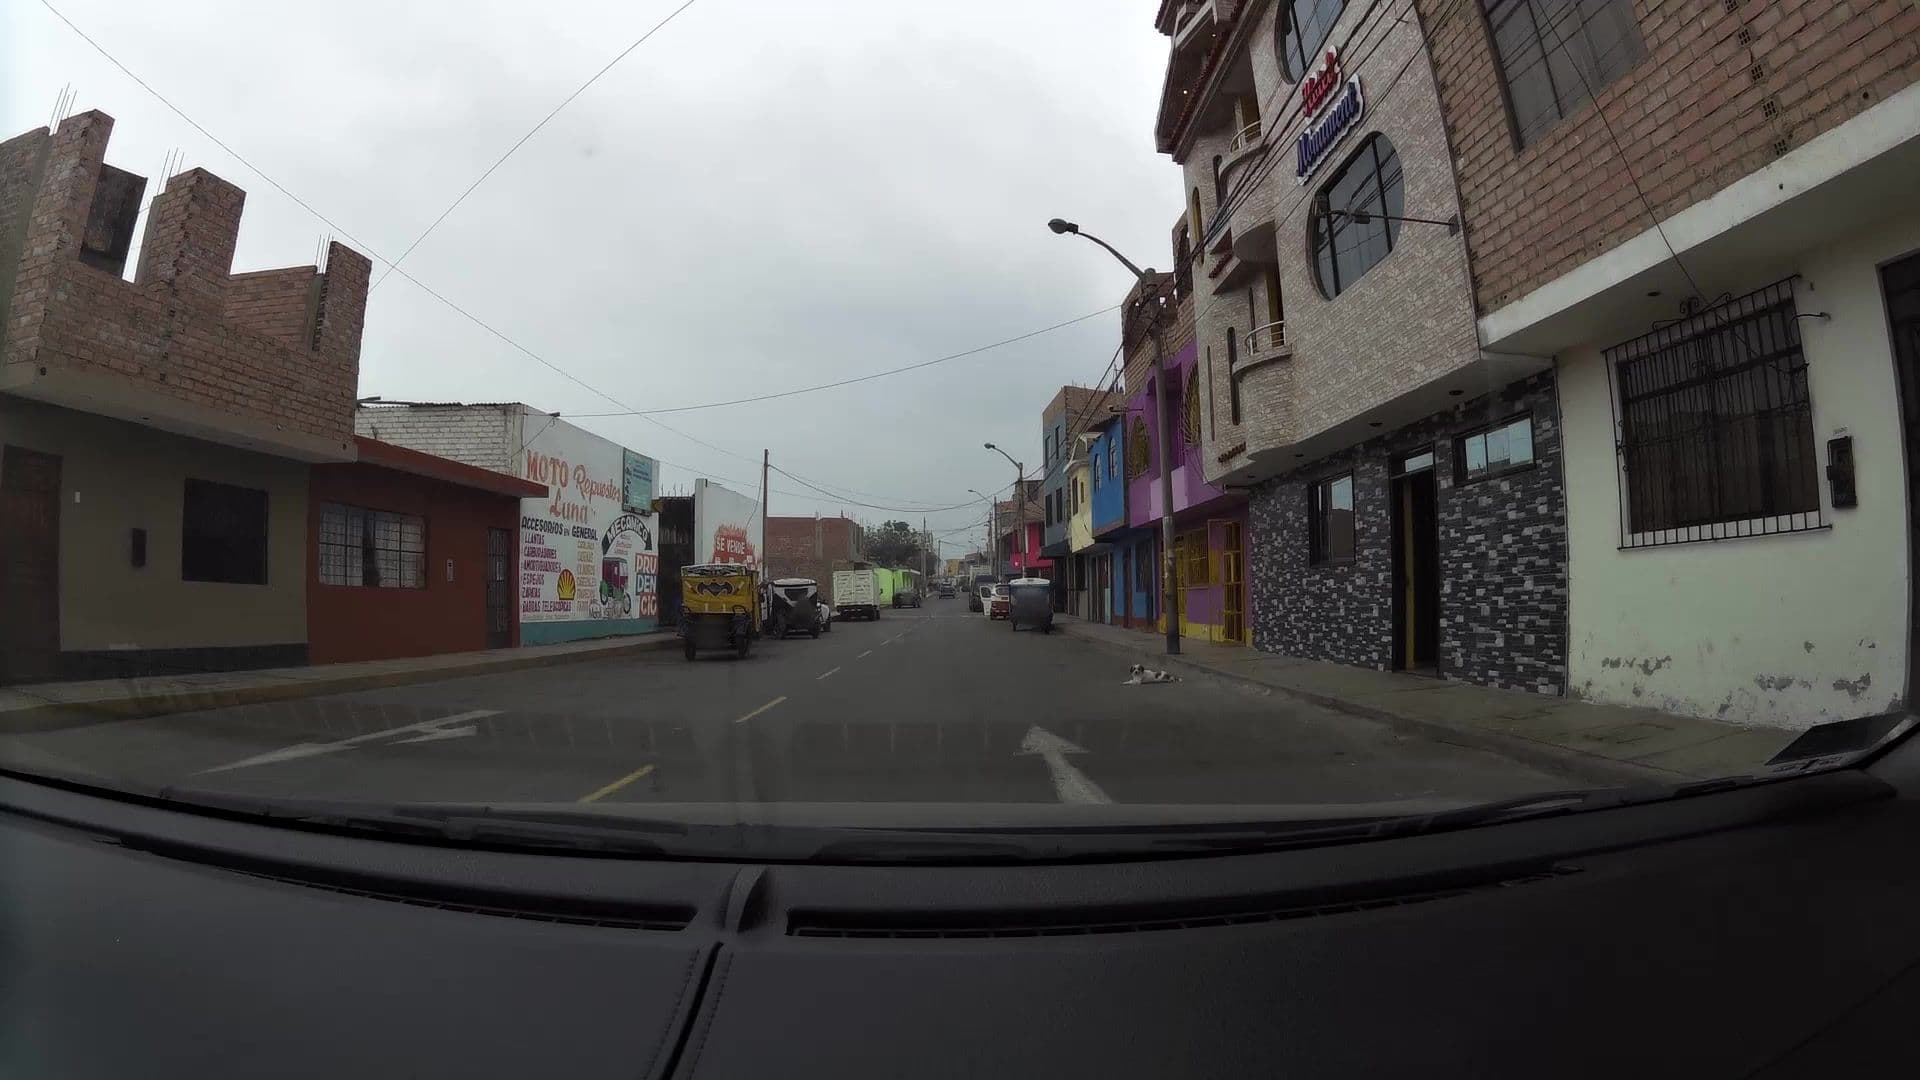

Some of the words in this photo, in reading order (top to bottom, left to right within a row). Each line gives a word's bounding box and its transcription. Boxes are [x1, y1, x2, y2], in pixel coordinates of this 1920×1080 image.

[1297, 81, 1360, 177] Monument
[527, 449, 569, 488] MOTO
[573, 464, 621, 504] Repuestos
[550, 487, 588, 524] Luna
[524, 532, 545, 545] LLANTAS
[716, 536, 725, 552] SE
[726, 539, 746, 555] VENDE
[636, 554, 657, 574] PRU
[522, 573, 545, 586] ESPEJOS
[637, 574, 657, 593] DEN
